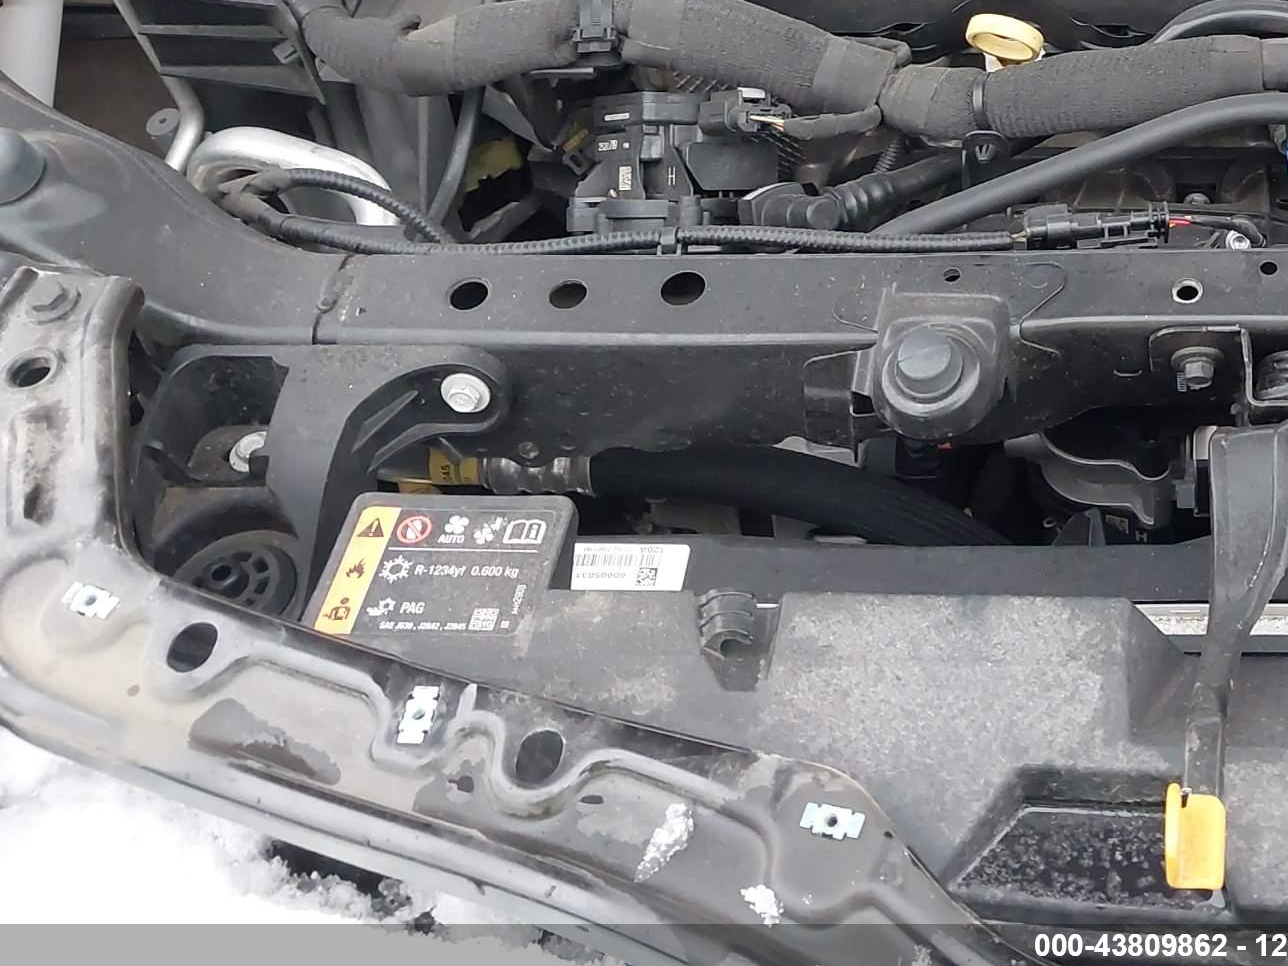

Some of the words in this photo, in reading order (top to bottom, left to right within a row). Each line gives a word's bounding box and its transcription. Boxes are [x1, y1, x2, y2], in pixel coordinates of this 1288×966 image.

[437, 534, 465, 544] AUTO
[414, 565, 465, 578] R-1234yf
[470, 566, 502, 577] 0.600
[504, 566, 519, 579] kg
[400, 601, 425, 615] PAG
